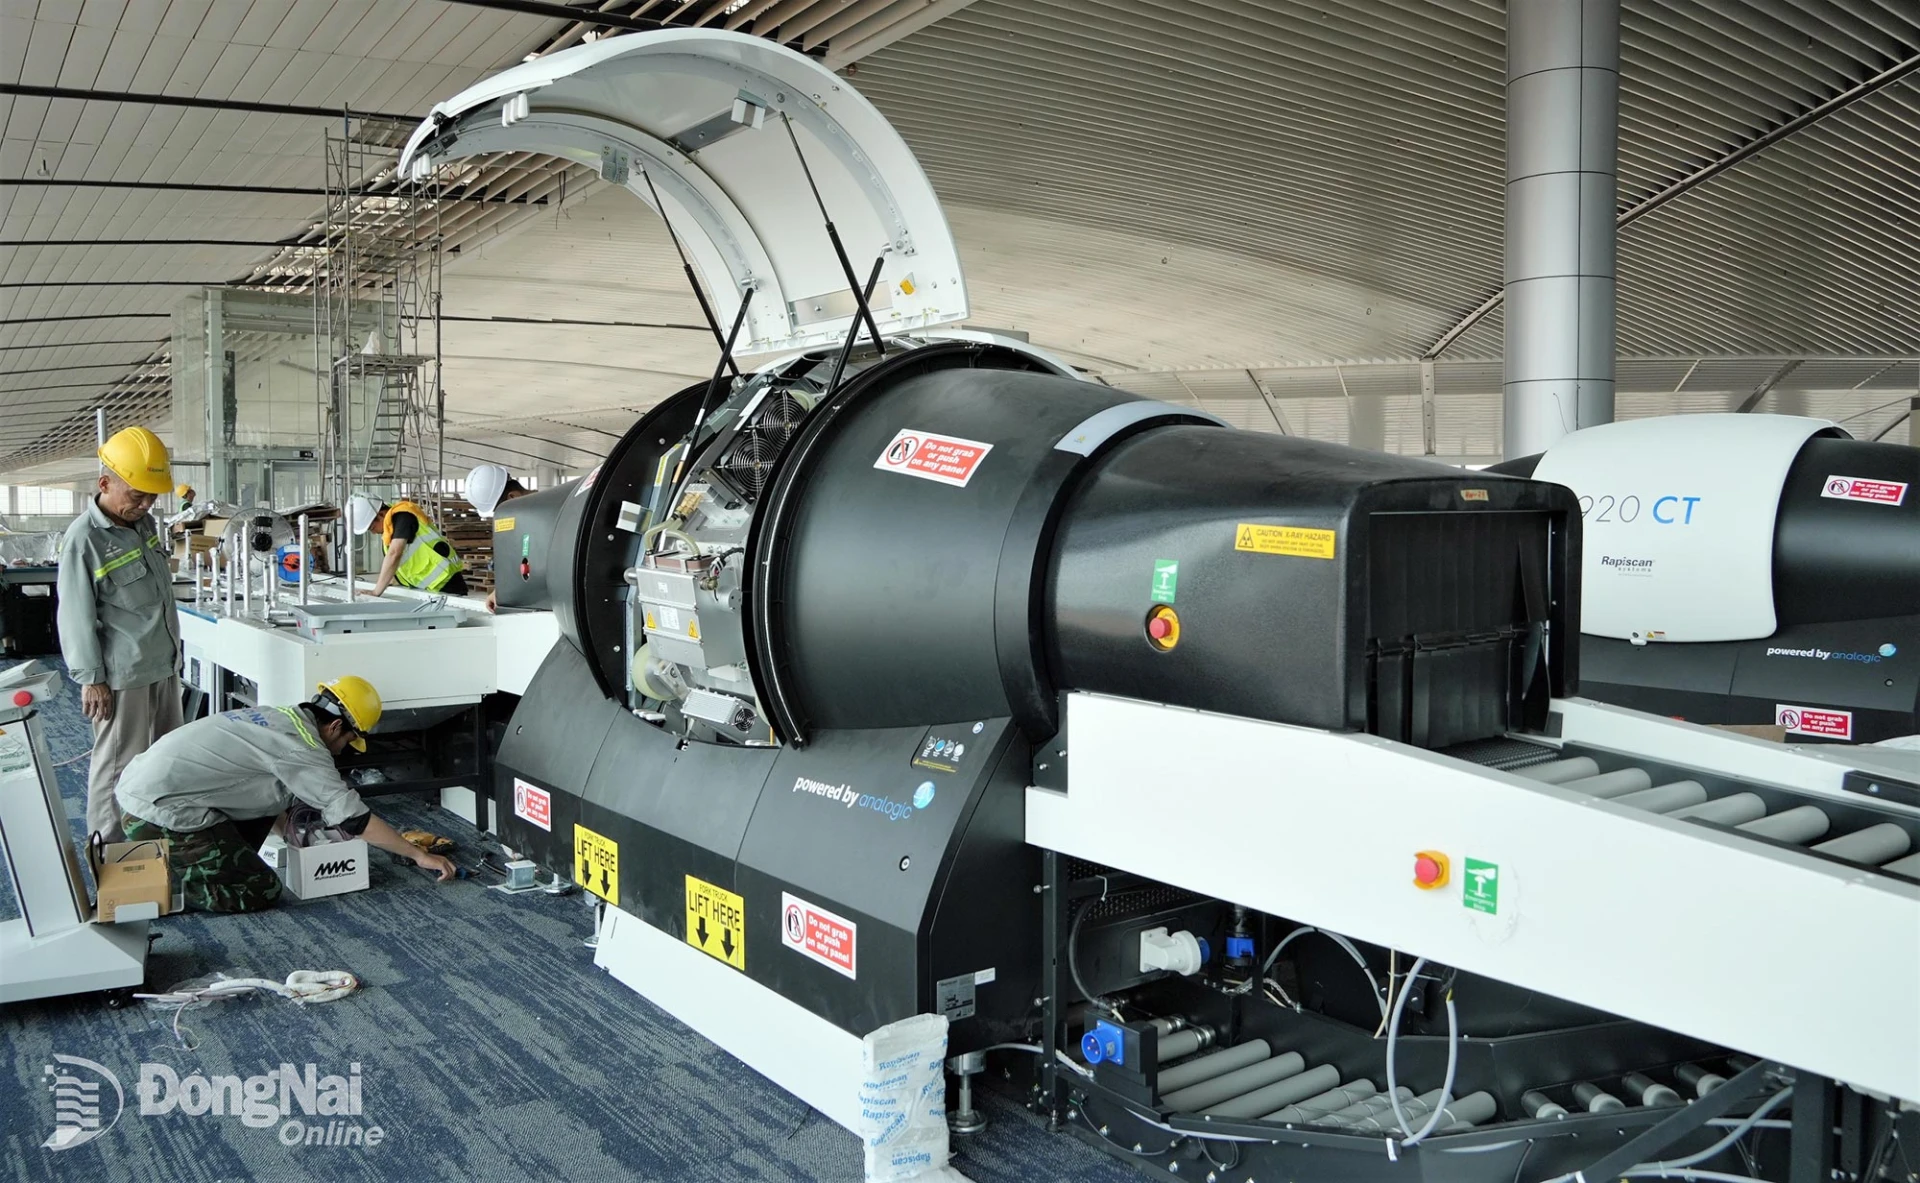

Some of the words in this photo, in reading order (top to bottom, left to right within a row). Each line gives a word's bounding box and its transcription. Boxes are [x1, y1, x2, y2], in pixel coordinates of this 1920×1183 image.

[925, 441, 937, 450] Do
[952, 449, 975, 457] grab
[923, 460, 940, 470] any
[938, 464, 967, 475] panel
[936, 454, 959, 464] push
[1652, 496, 1701, 525] CT
[1601, 556, 1653, 568] Rapiscan
[1766, 647, 1815, 658] powered
[1815, 649, 1831, 660] by
[1832, 652, 1881, 664] analogic
[793, 777, 845, 800] powered
[841, 785, 860, 808] by
[859, 794, 912, 821] analogic
[577, 837, 592, 860] LIFT
[594, 845, 615, 872] HERE
[700, 884, 711, 895] FORK
[713, 889, 728, 902] TRUCK
[689, 890, 709, 917] LIFT
[713, 900, 740, 931] HERE
[808, 914, 818, 927] Do
[819, 922, 830, 933] not
[831, 928, 848, 941] grab
[815, 930, 823, 940] or
[824, 934, 840, 948] push
[806, 937, 816, 947] on
[816, 942, 829, 955] any
[830, 948, 849, 963] panel
